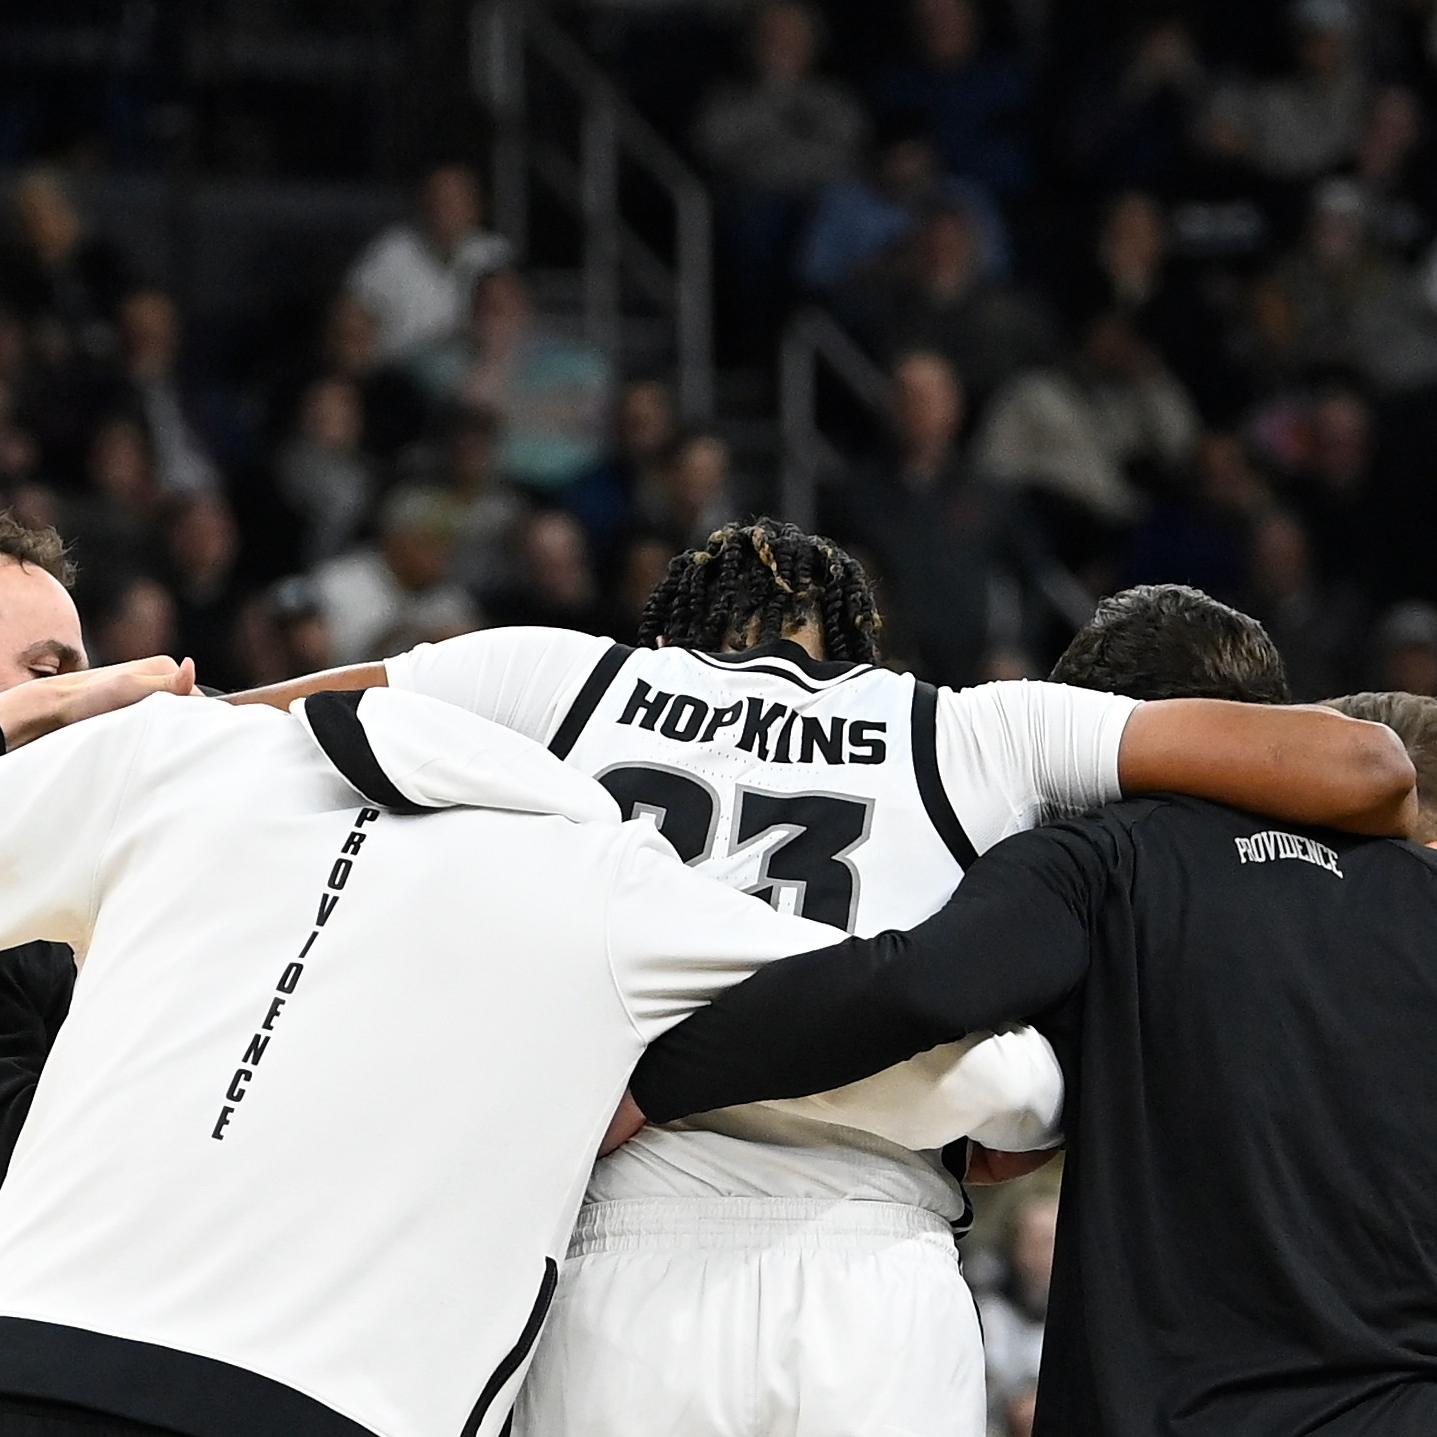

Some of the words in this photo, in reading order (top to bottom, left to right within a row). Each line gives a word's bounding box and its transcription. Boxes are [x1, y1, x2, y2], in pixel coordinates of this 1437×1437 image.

[616, 678, 887, 765] HOPKINS
[1234, 830, 1344, 879] PROVIDENCE
[211, 807, 381, 1141] PROVIDENCE
